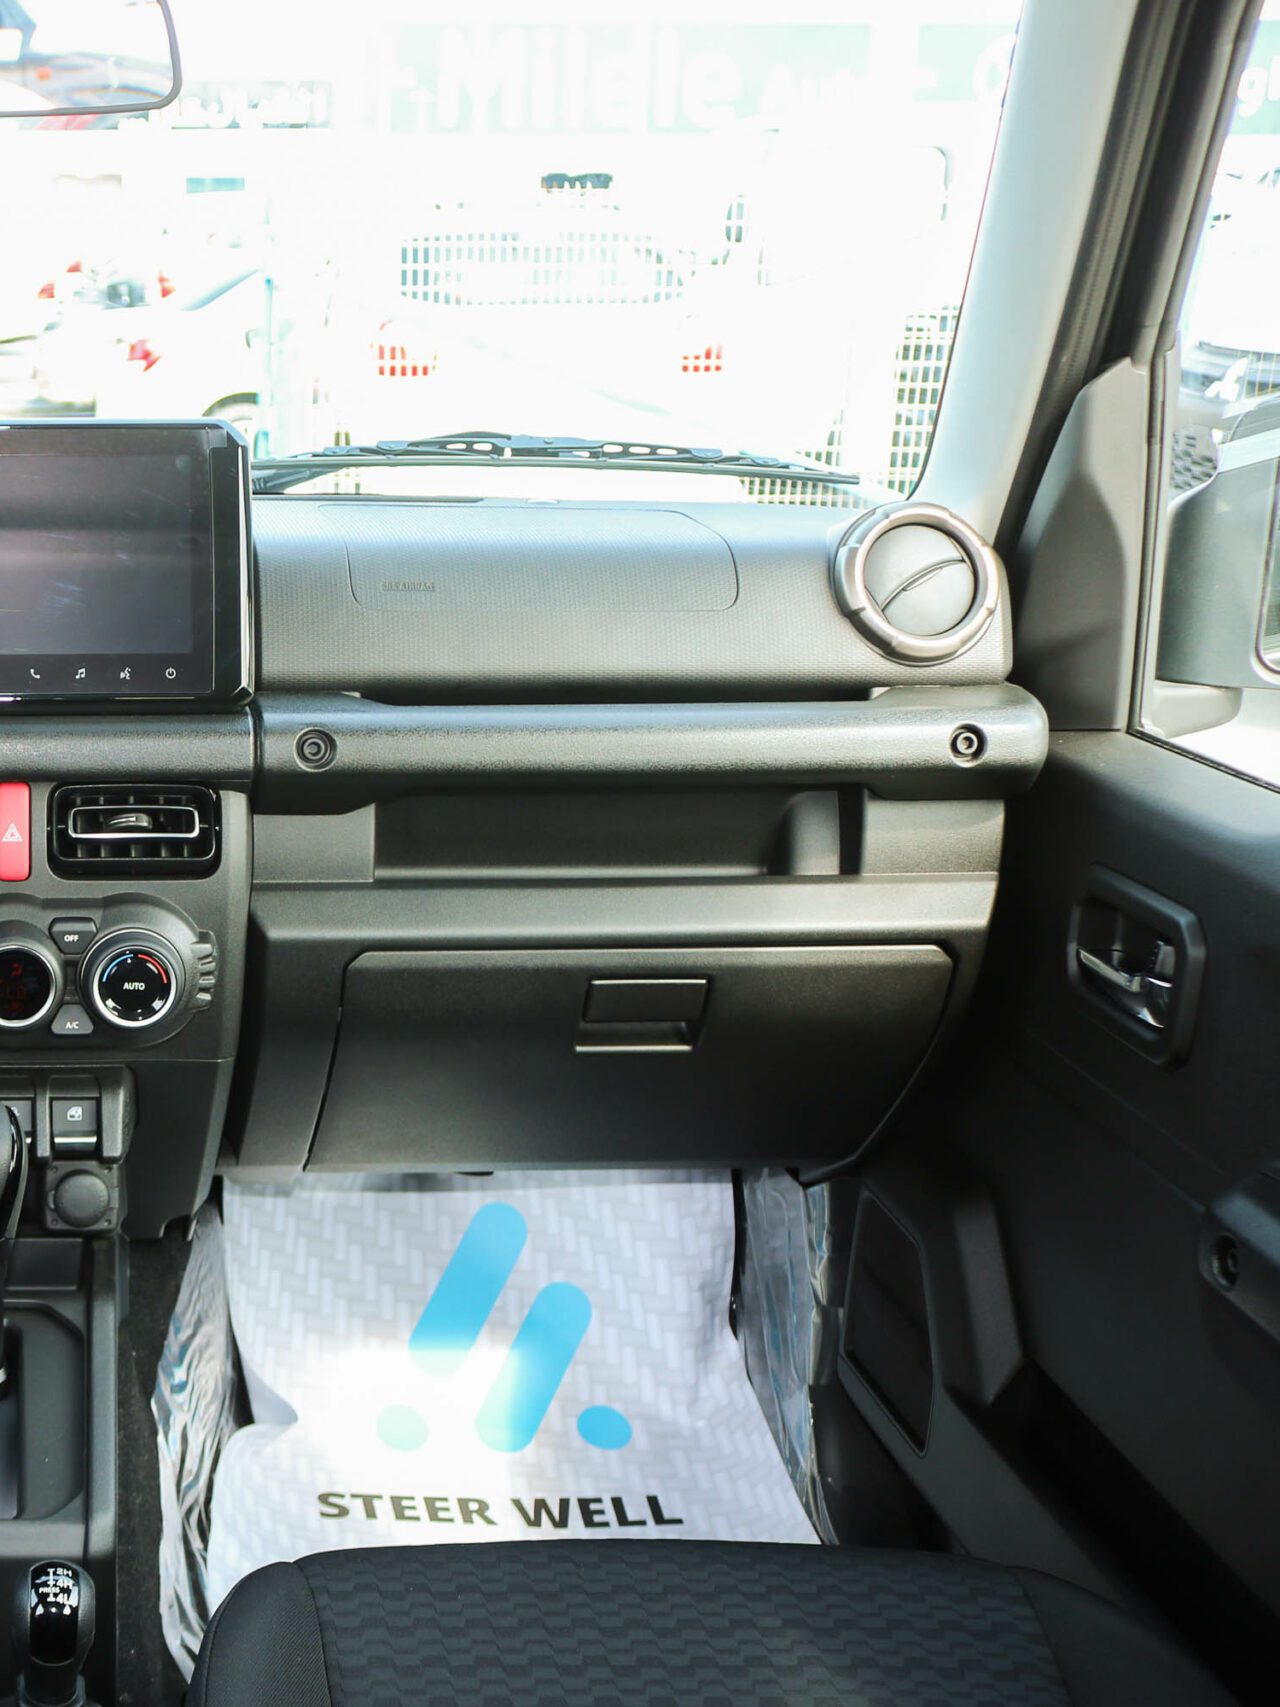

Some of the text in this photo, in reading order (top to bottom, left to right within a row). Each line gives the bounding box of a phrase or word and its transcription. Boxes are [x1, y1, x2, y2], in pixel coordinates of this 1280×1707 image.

[64, 933, 80, 944] OFF
[123, 982, 146, 991] AUTO
[65, 1020, 80, 1031] A/C
[316, 1491, 684, 1529] STEER WELL
[56, 1567, 73, 1577] 2H
